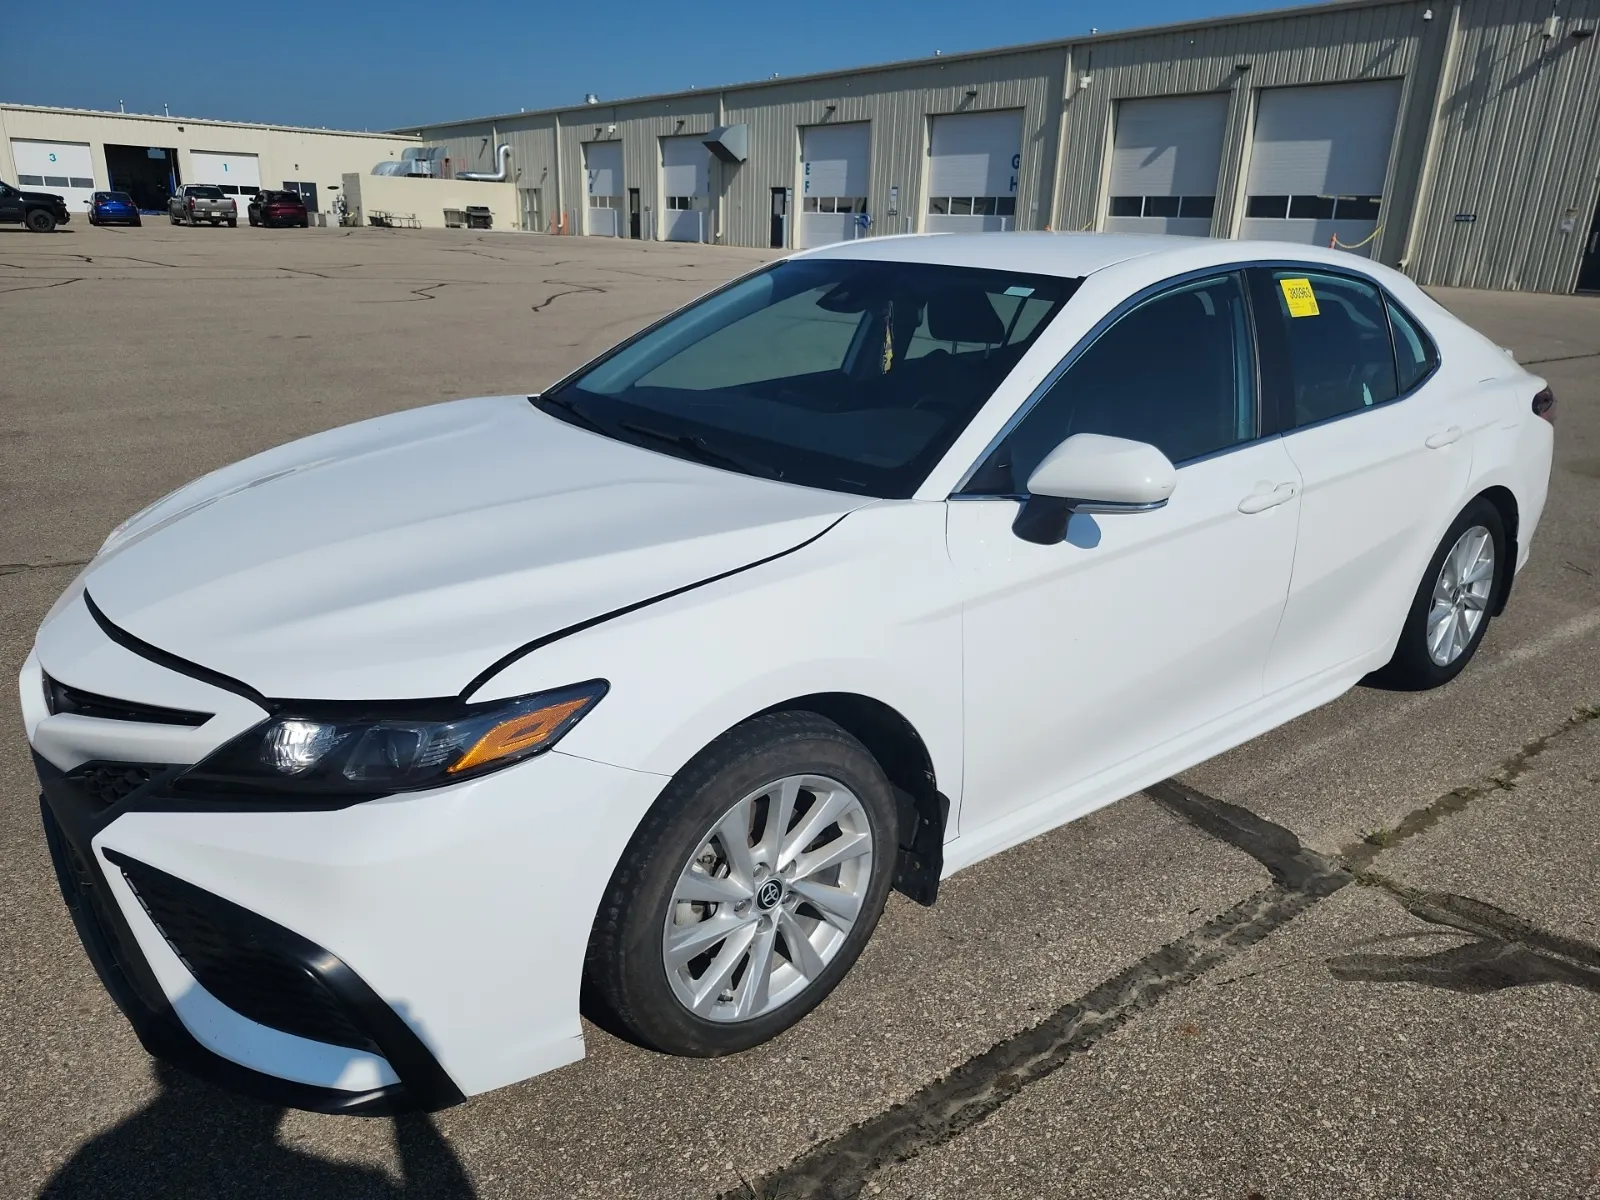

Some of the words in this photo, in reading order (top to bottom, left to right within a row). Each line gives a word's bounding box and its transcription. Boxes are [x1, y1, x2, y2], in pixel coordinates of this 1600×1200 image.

[49, 153, 57, 162] 3
[1012, 154, 1020, 169] G
[223, 163, 228, 172] 1
[805, 162, 810, 175] E
[804, 180, 810, 193] F
